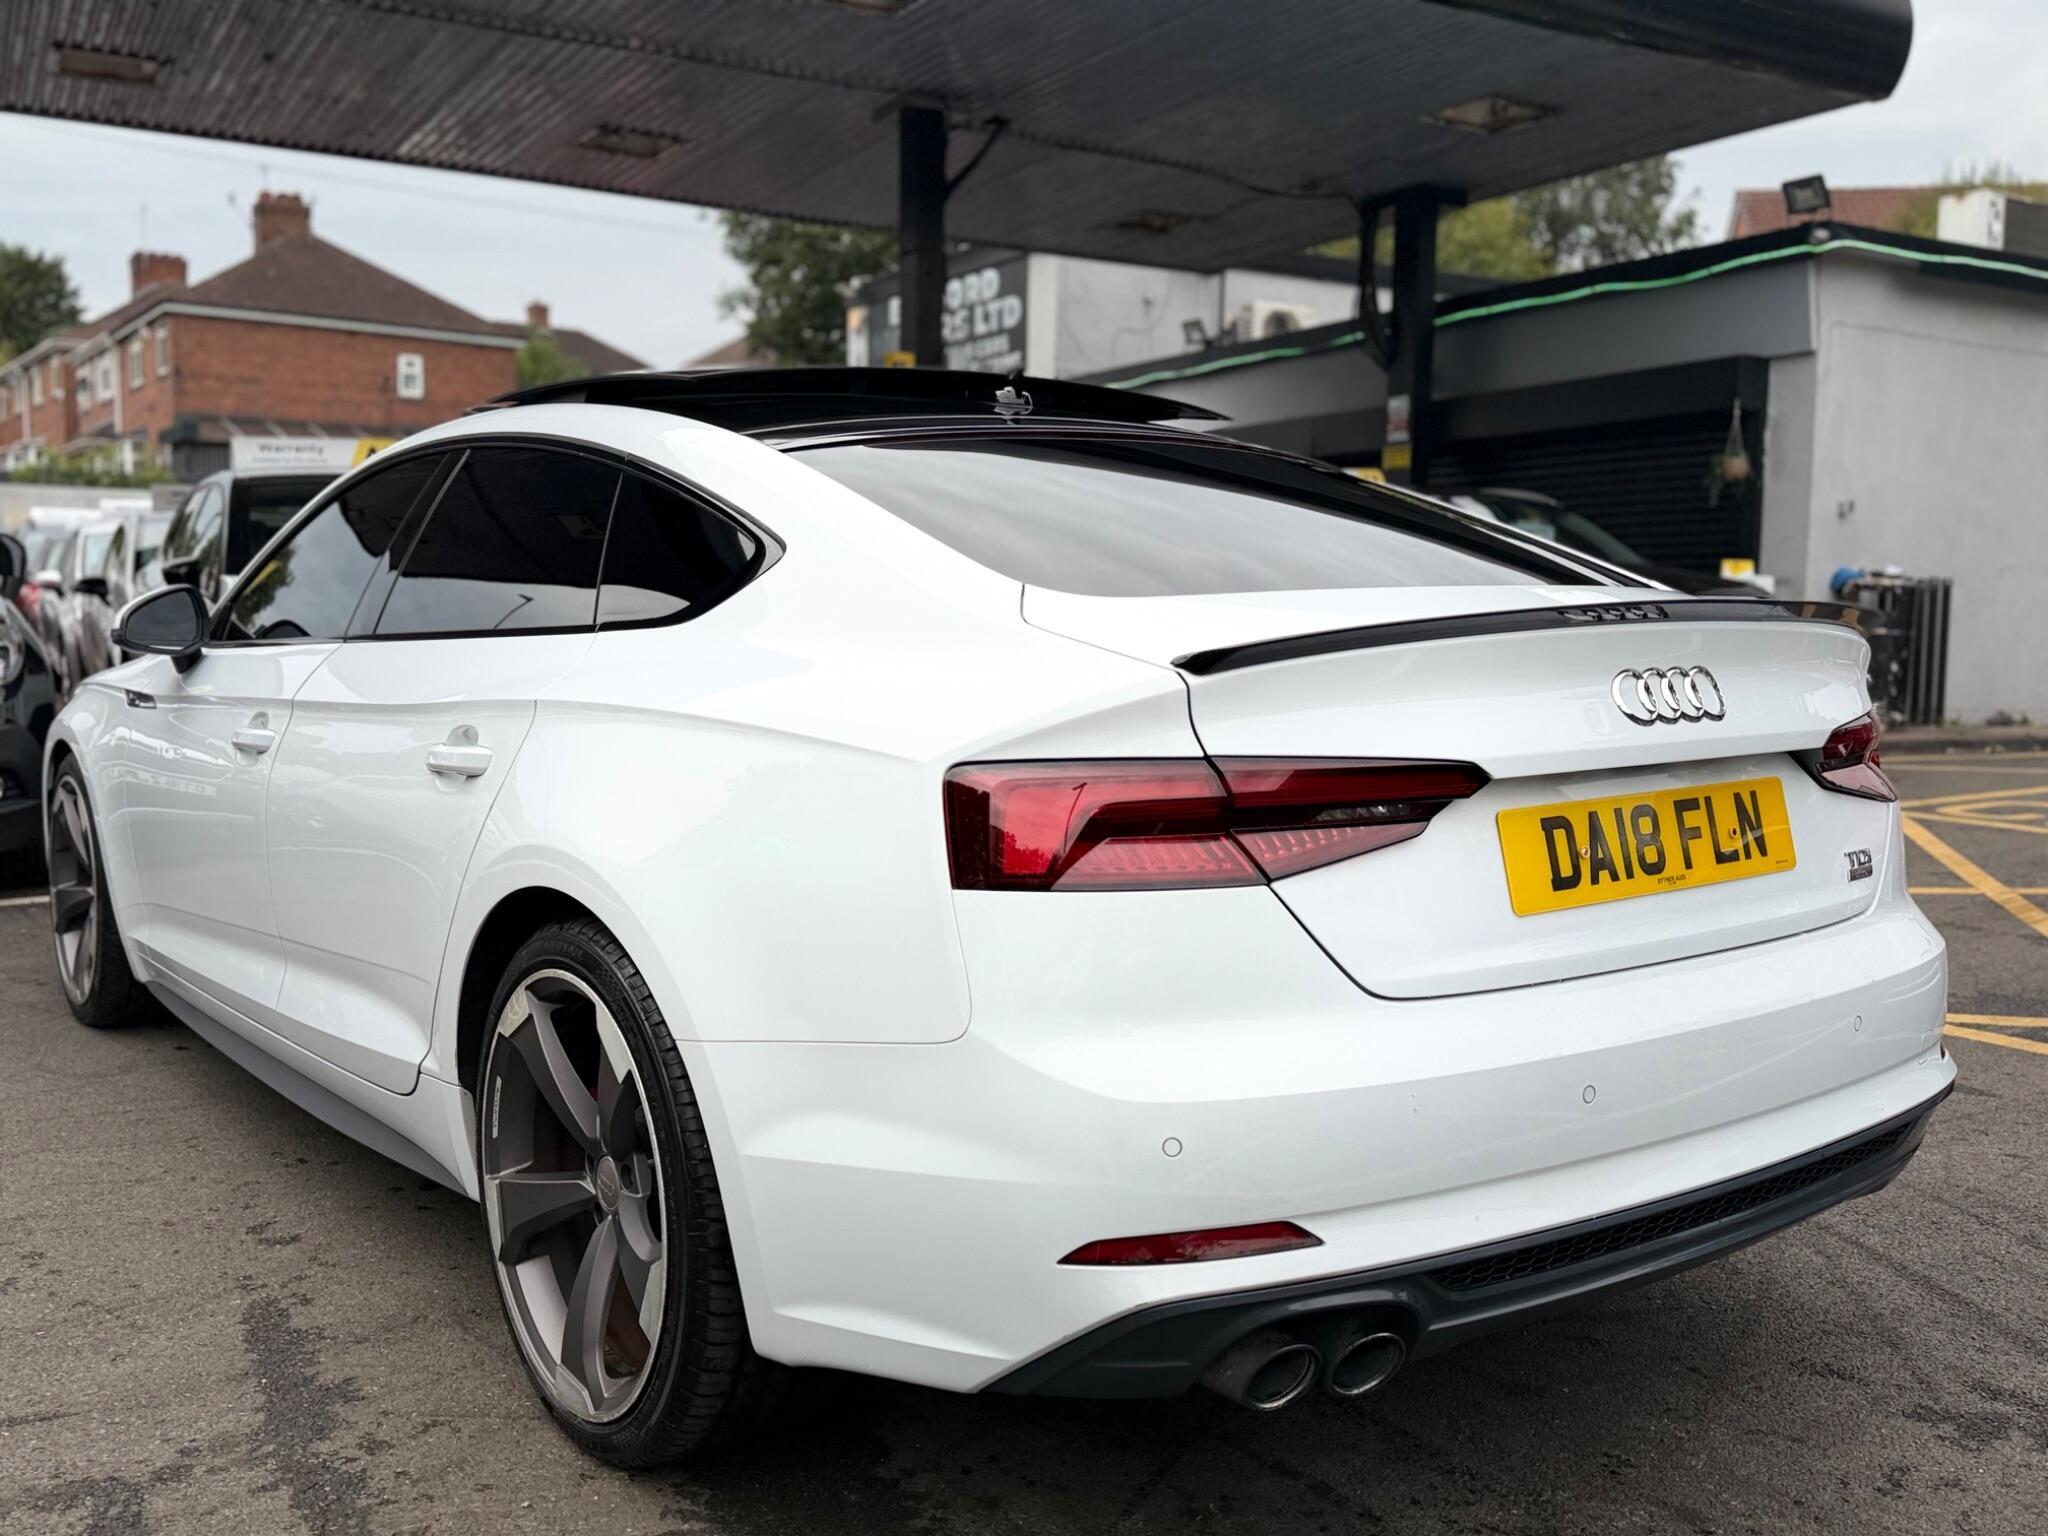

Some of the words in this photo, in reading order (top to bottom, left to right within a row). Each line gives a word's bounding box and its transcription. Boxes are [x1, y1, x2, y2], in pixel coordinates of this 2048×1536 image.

[973, 294, 1023, 338] LTD
[257, 443, 325, 455] Warranty
[1540, 804, 1667, 892] DA18
[1672, 789, 1769, 870] FLN
